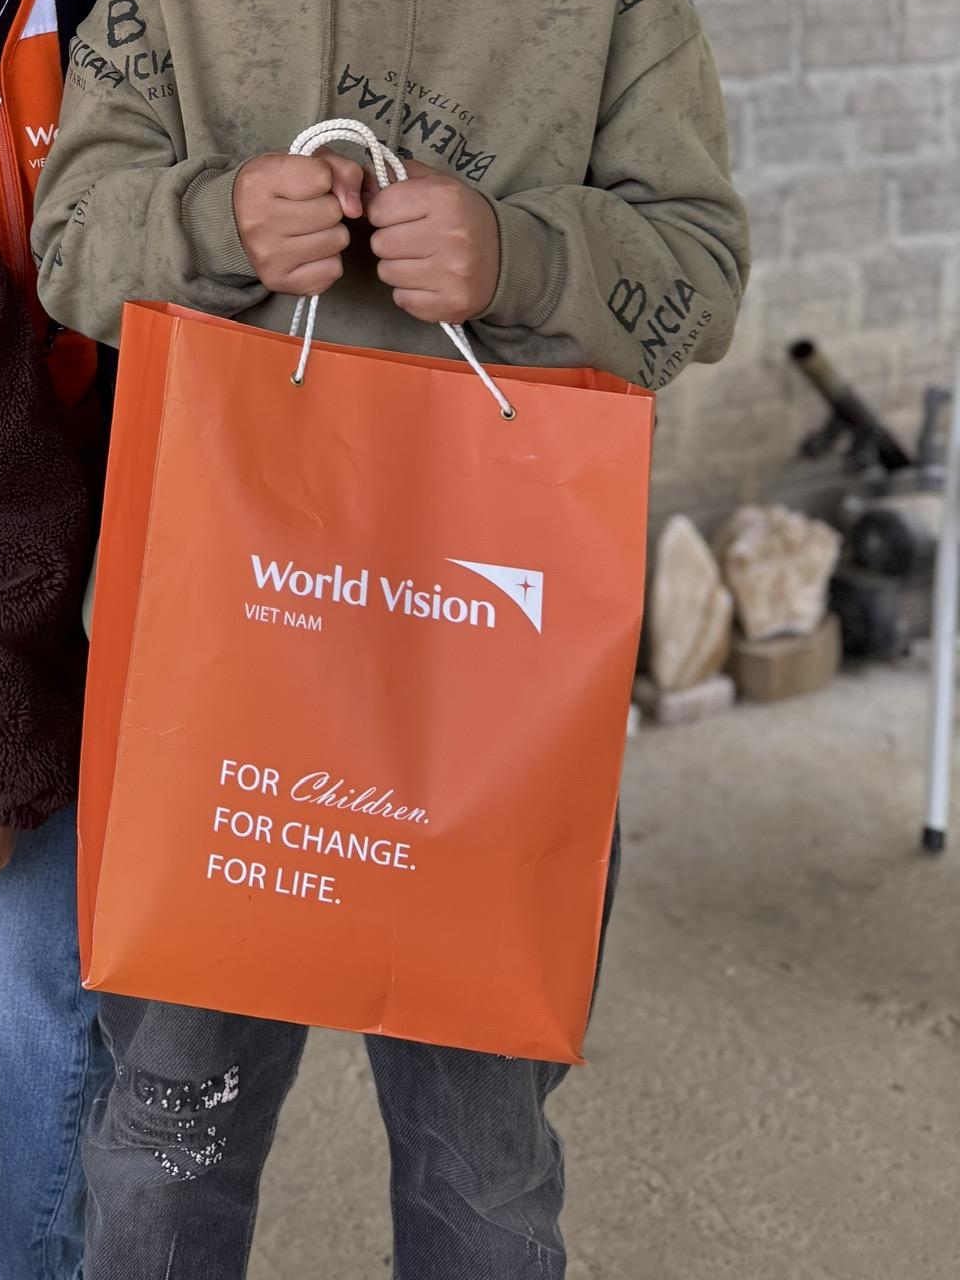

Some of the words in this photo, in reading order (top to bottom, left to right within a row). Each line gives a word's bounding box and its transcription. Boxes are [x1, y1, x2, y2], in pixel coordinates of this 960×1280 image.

[607, 278, 647, 334] B
[245, 603, 281, 624] VIET
[283, 610, 322, 632] NAM
[250, 554, 369, 607] World
[379, 576, 496, 629] Vision
[220, 759, 280, 796] FOR
[290, 771, 430, 824] Children.
[213, 806, 273, 844] FOR
[281, 821, 416, 869] CHANGE.
[207, 853, 267, 890] FOR
[275, 867, 341, 905] LIFE.
